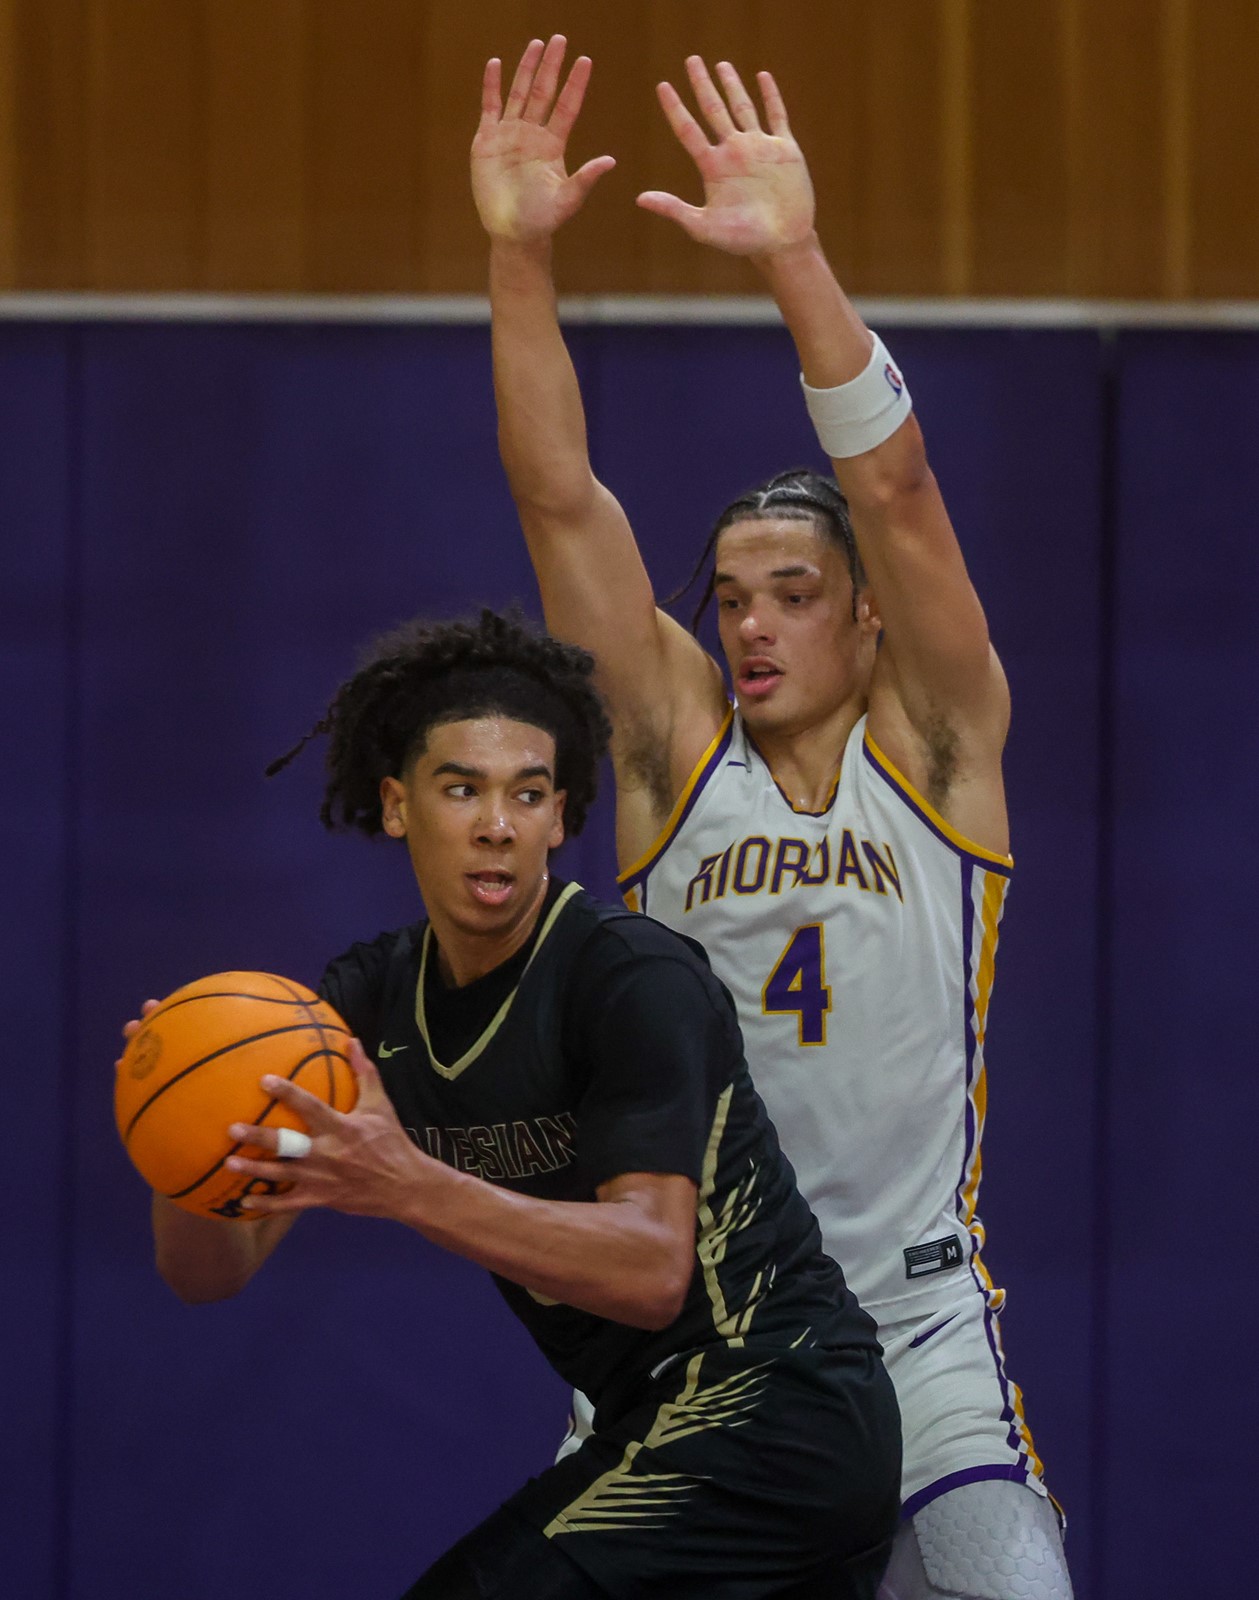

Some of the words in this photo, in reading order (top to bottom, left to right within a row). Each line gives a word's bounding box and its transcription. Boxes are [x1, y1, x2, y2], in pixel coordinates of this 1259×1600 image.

[684, 828, 904, 913] RIORDAN
[761, 922, 832, 1046] 4
[946, 1245, 957, 1260] M
